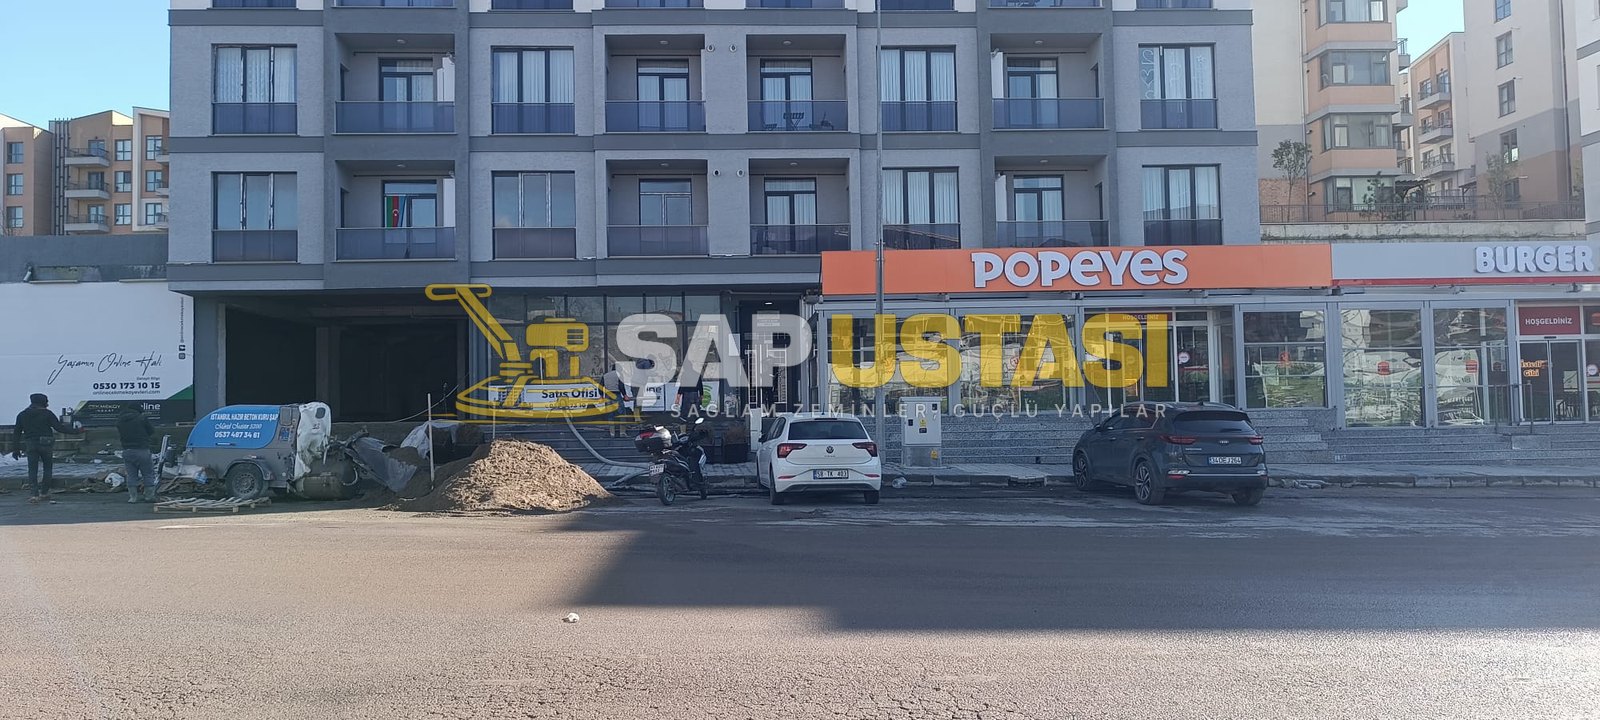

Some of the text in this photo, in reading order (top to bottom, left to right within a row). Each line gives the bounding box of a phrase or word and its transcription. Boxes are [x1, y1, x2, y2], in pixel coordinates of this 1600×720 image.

[1475, 245, 1594, 273] BURGER
[1525, 317, 1573, 326] HOŞGELDİNİZ
[93, 382, 117, 390] 0530
[150, 381, 160, 389] 15
